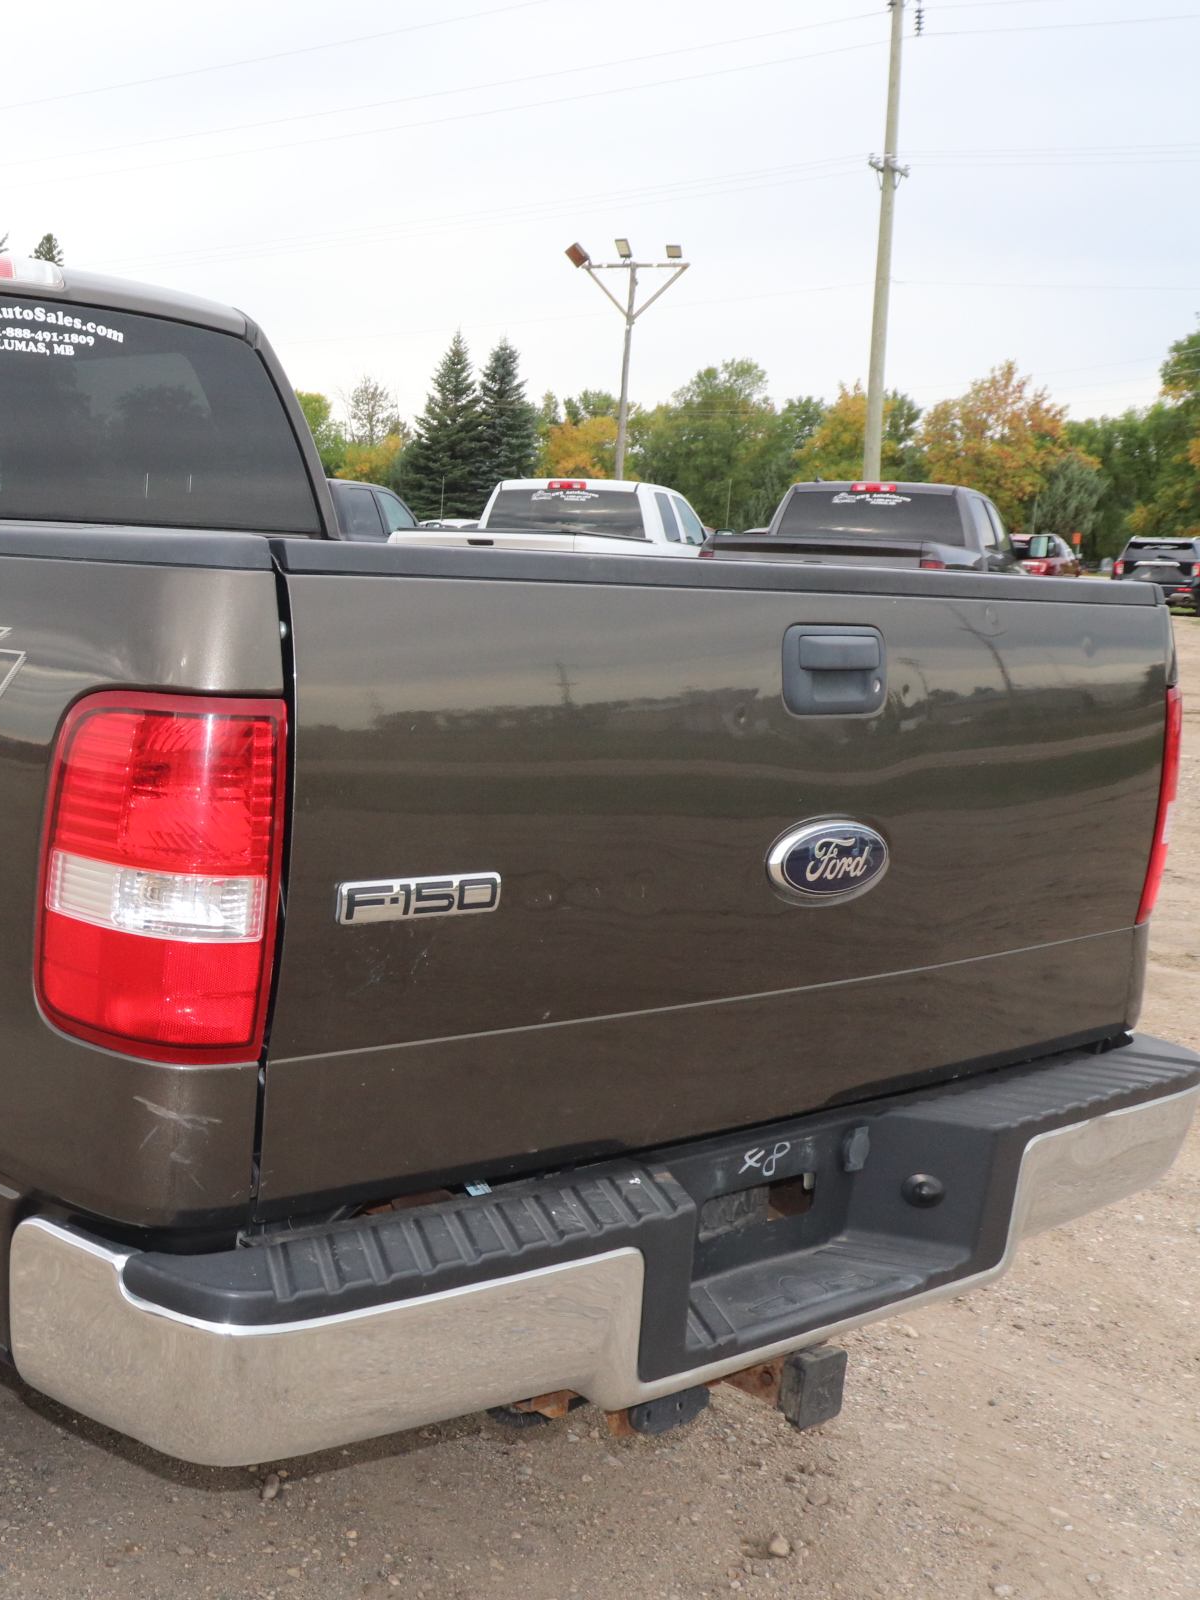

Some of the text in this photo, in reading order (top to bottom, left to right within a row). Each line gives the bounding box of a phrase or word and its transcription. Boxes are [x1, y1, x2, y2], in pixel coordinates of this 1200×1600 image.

[53, 343, 75, 356] MB
[805, 837, 870, 882] Ford
[346, 876, 498, 920] F-150
